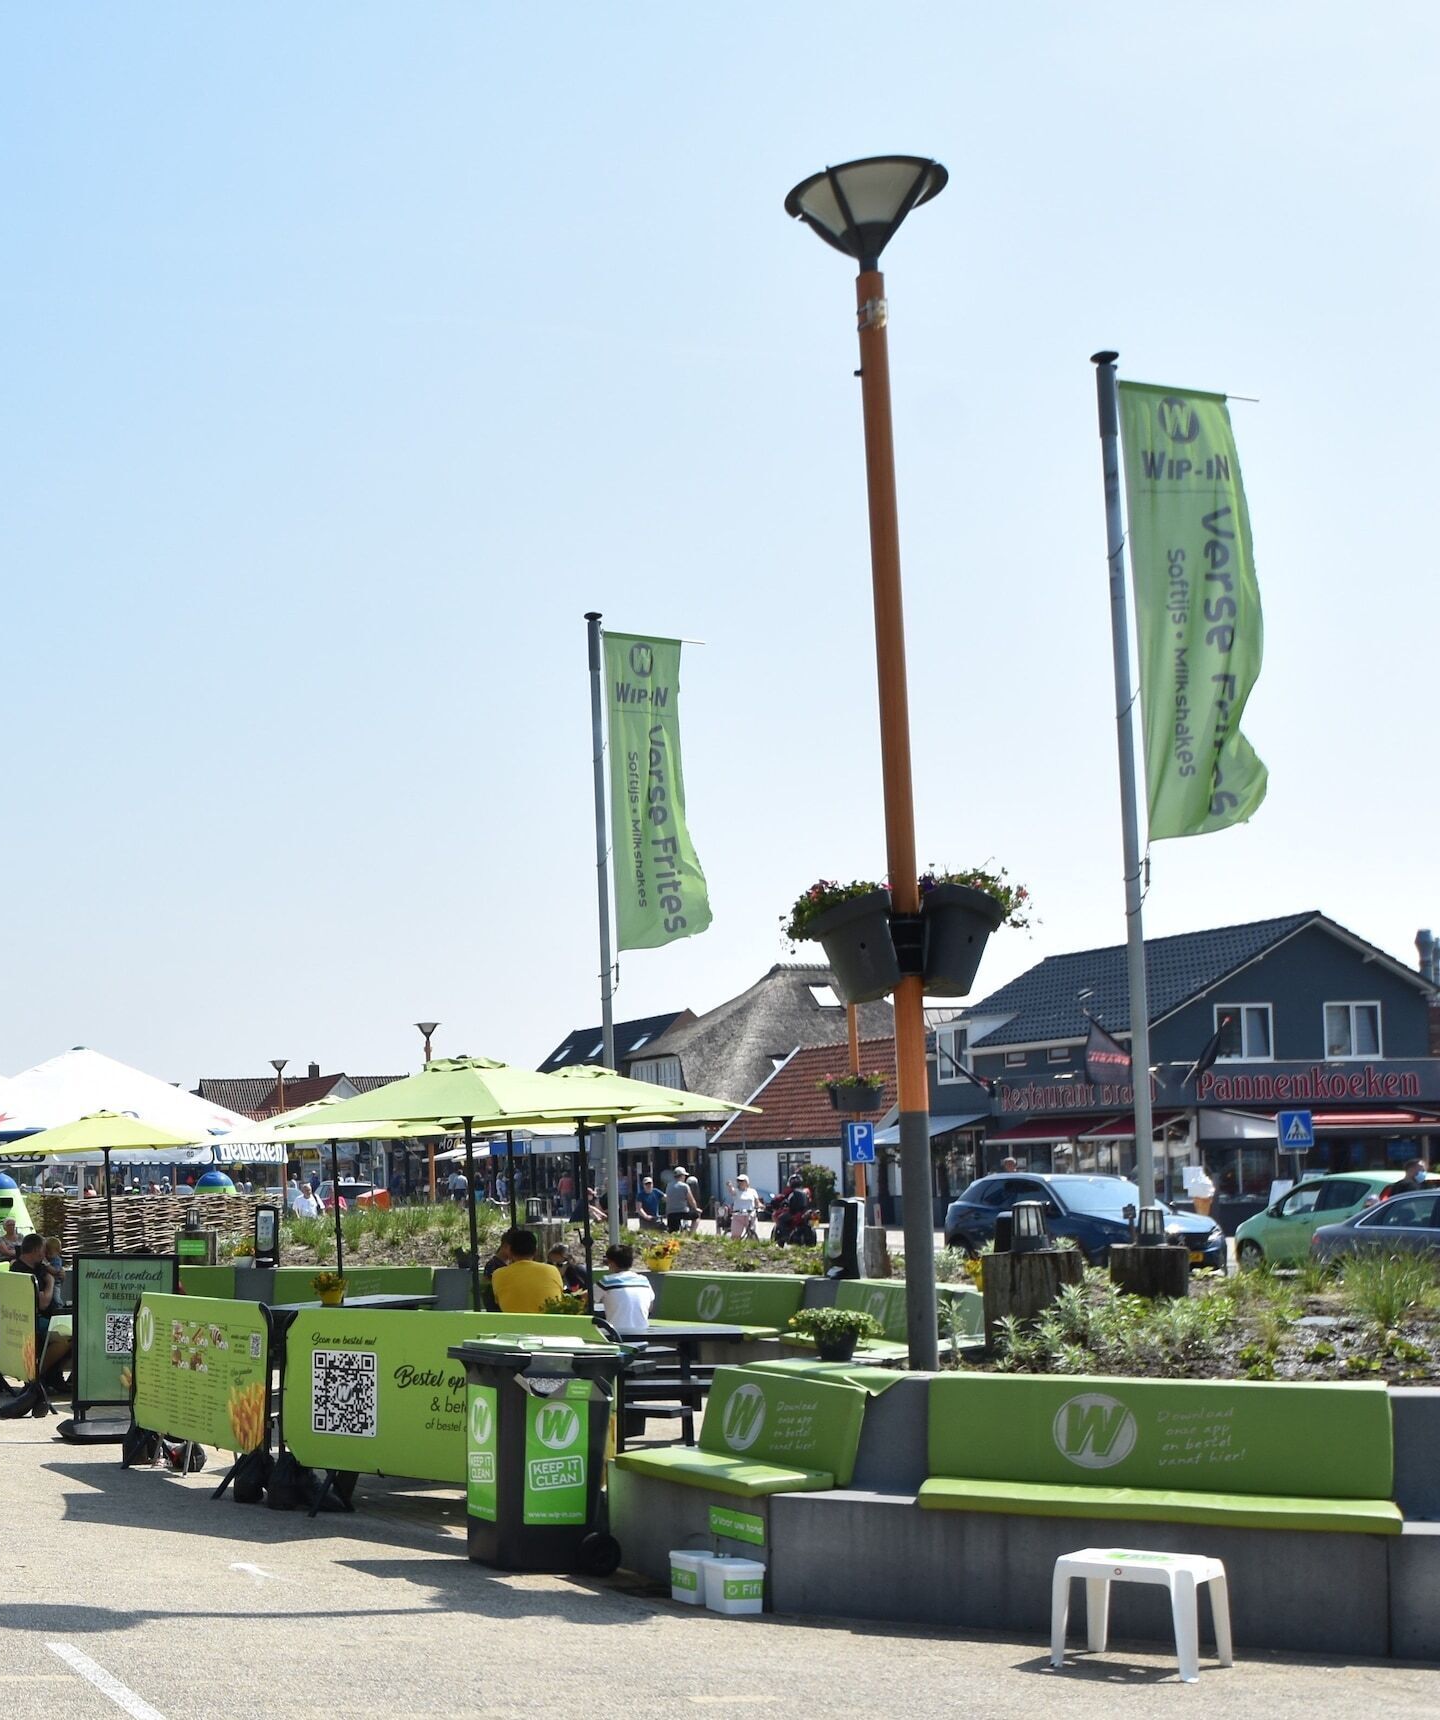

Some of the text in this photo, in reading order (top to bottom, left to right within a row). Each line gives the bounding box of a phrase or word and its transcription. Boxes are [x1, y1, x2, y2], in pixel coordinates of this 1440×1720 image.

[1201, 505, 1237, 654] Verse
[1167, 548, 1196, 778] Softijs Milkshakes
[628, 751, 647, 908] Softijs Milkshakes
[648, 724, 687, 934] Verse Frites
[1196, 1065, 1422, 1101] Pannenkoeken
[1001, 1081, 1096, 1113] Restaurant
[853, 1125, 868, 1146] P
[85, 1268, 163, 1281] minder contact
[103, 1282, 118, 1290] MET
[332, 1337, 341, 1345] en
[343, 1336, 363, 1345] bestel
[393, 1364, 445, 1389] Bestel
[430, 1397, 441, 1412] &
[1157, 1407, 1234, 1423] Download
[425, 1418, 462, 1432] of bestel
[1203, 1424, 1231, 1436] app
[1161, 1435, 1232, 1452] en bestel
[470, 1456, 492, 1467] KEEP IT
[1158, 1448, 1247, 1466] vanaf hier!
[471, 1467, 491, 1479] CLEAN
[533, 1460, 579, 1475] KEEP IT
[535, 1473, 577, 1487] CLEAN
[742, 1584, 761, 1595] Fifi
